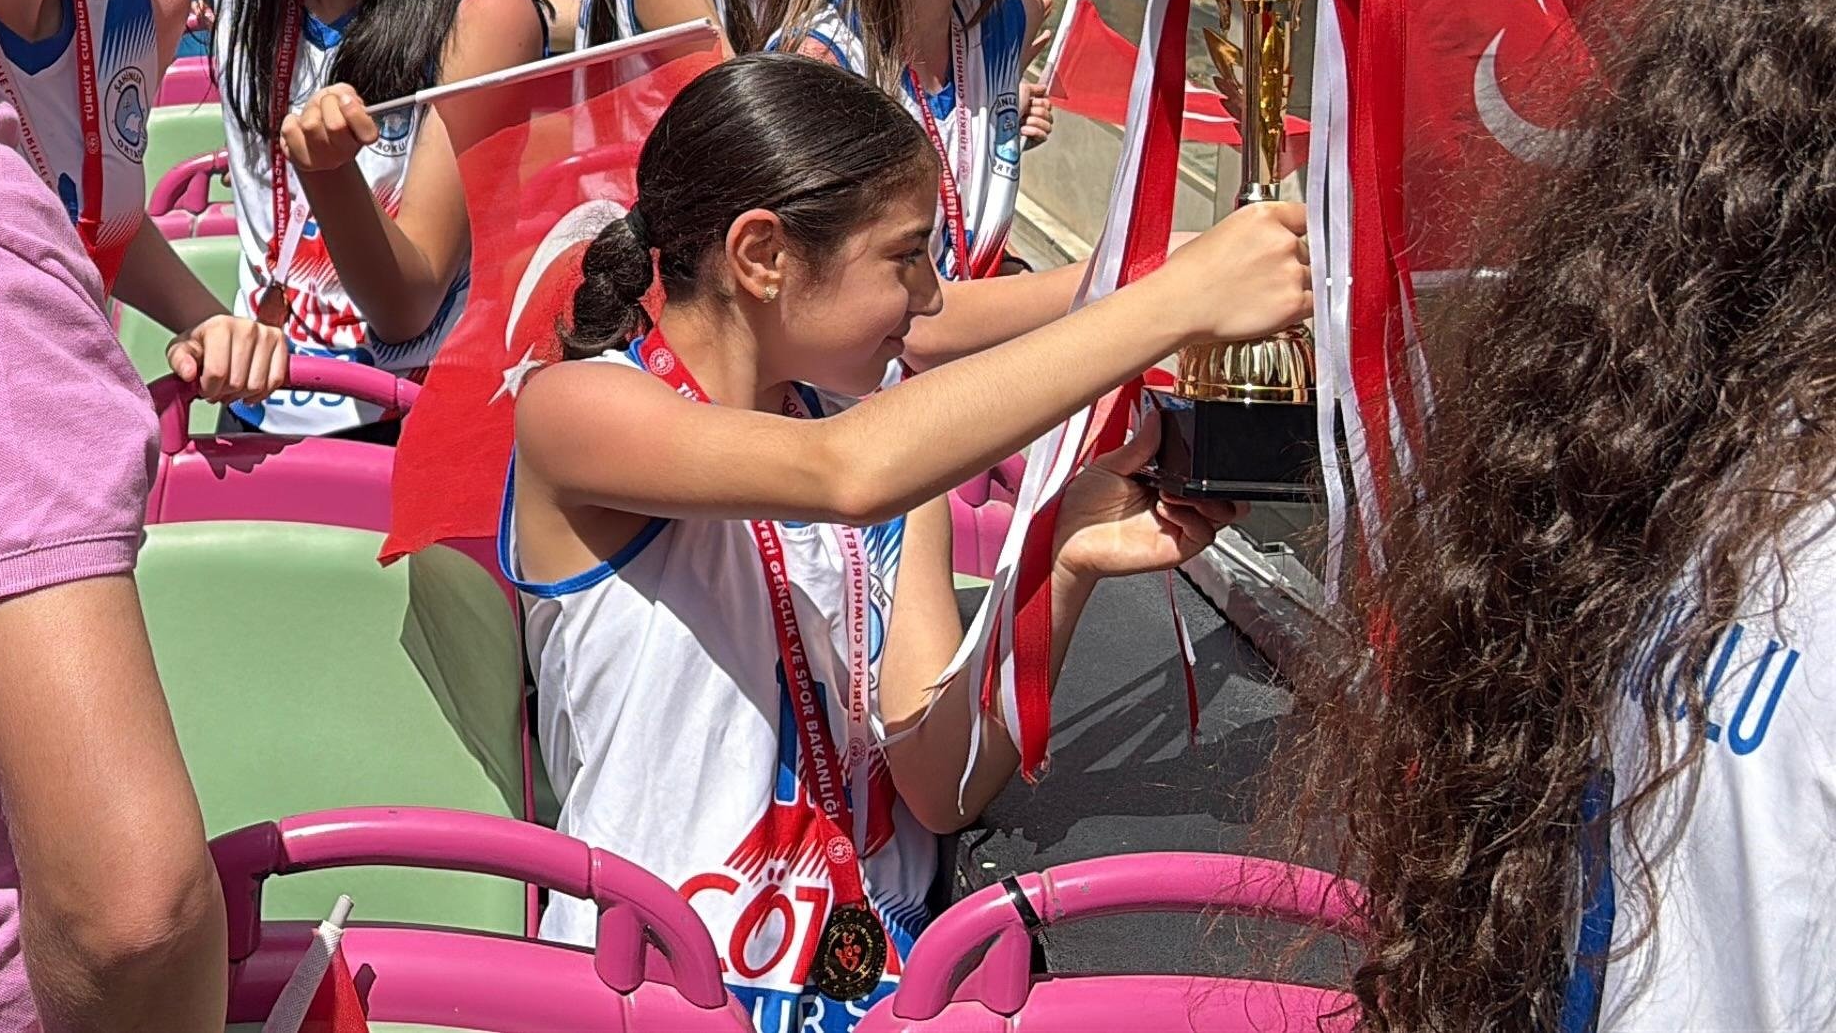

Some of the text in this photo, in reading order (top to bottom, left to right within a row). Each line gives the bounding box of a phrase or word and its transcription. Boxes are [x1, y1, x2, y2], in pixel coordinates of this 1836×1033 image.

[83, 64, 96, 120] TÜRKİYE
[788, 643, 804, 664] VE
[794, 666, 815, 717] SPOR
[805, 719, 839, 821] BAKANLIĞI
